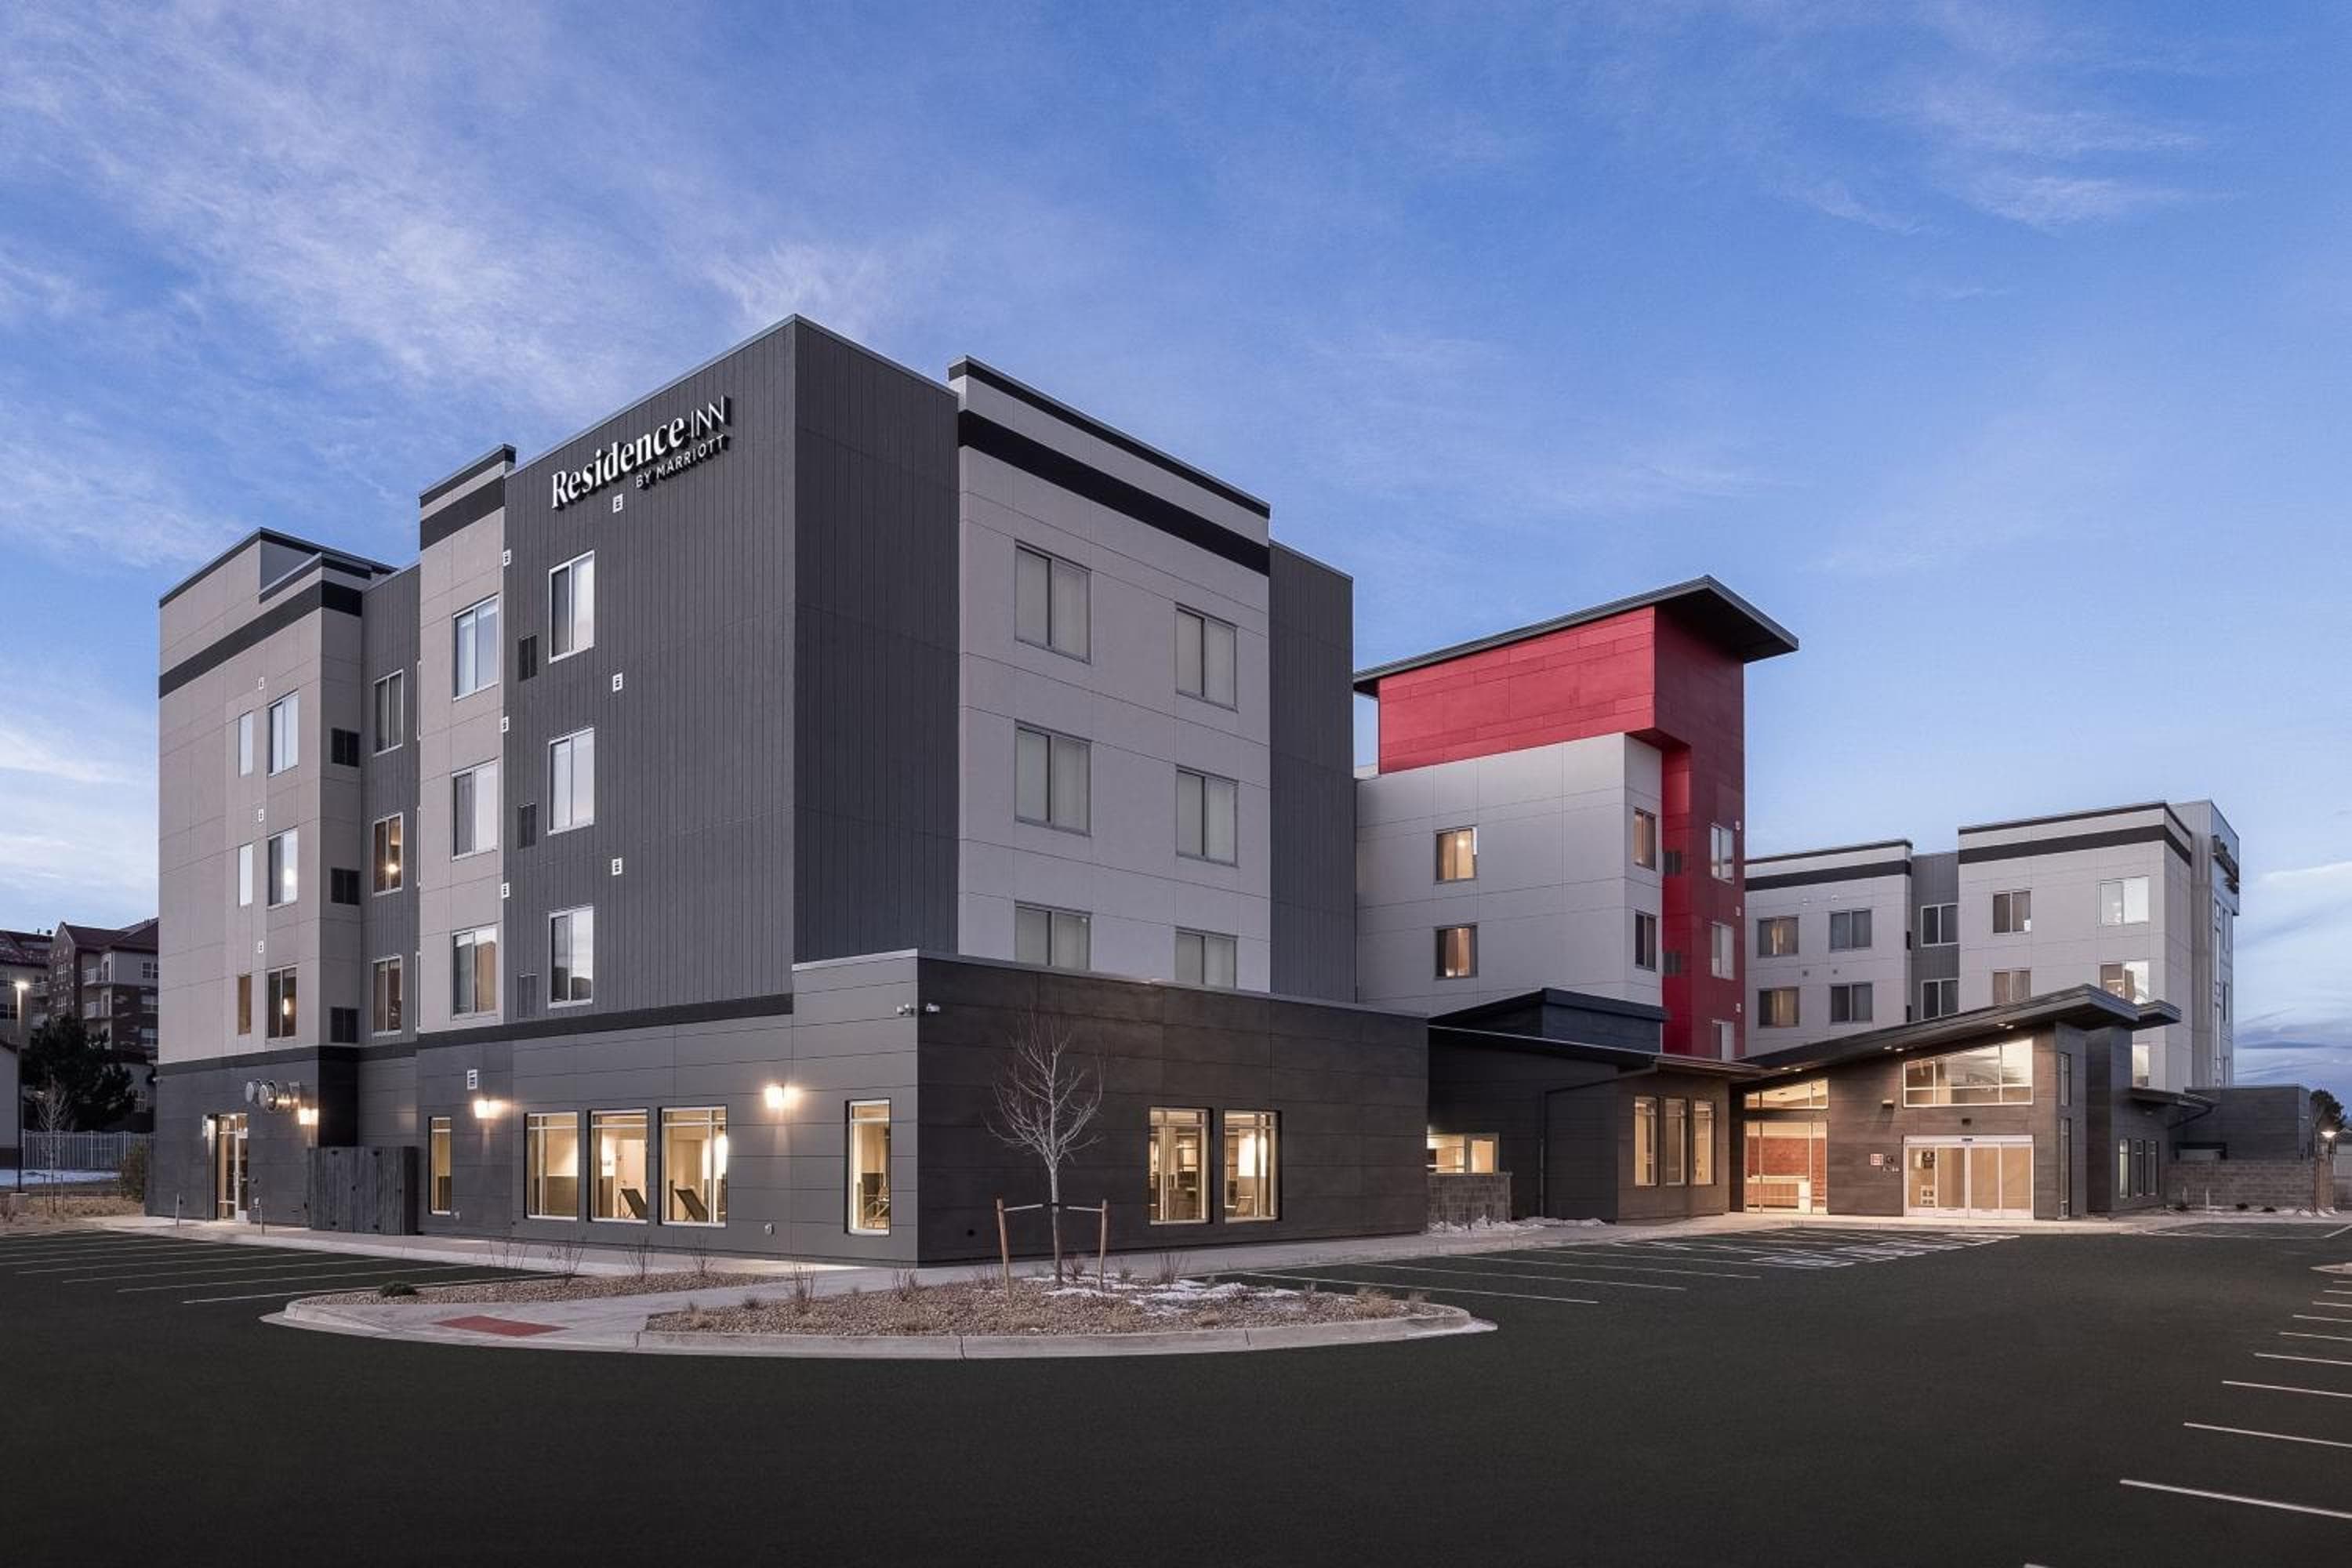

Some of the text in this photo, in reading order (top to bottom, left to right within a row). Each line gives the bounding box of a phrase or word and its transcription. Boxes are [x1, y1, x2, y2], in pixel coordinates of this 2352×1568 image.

[551, 394, 726, 509] Residence INN
[636, 434, 725, 488] BY MARRIOTT
